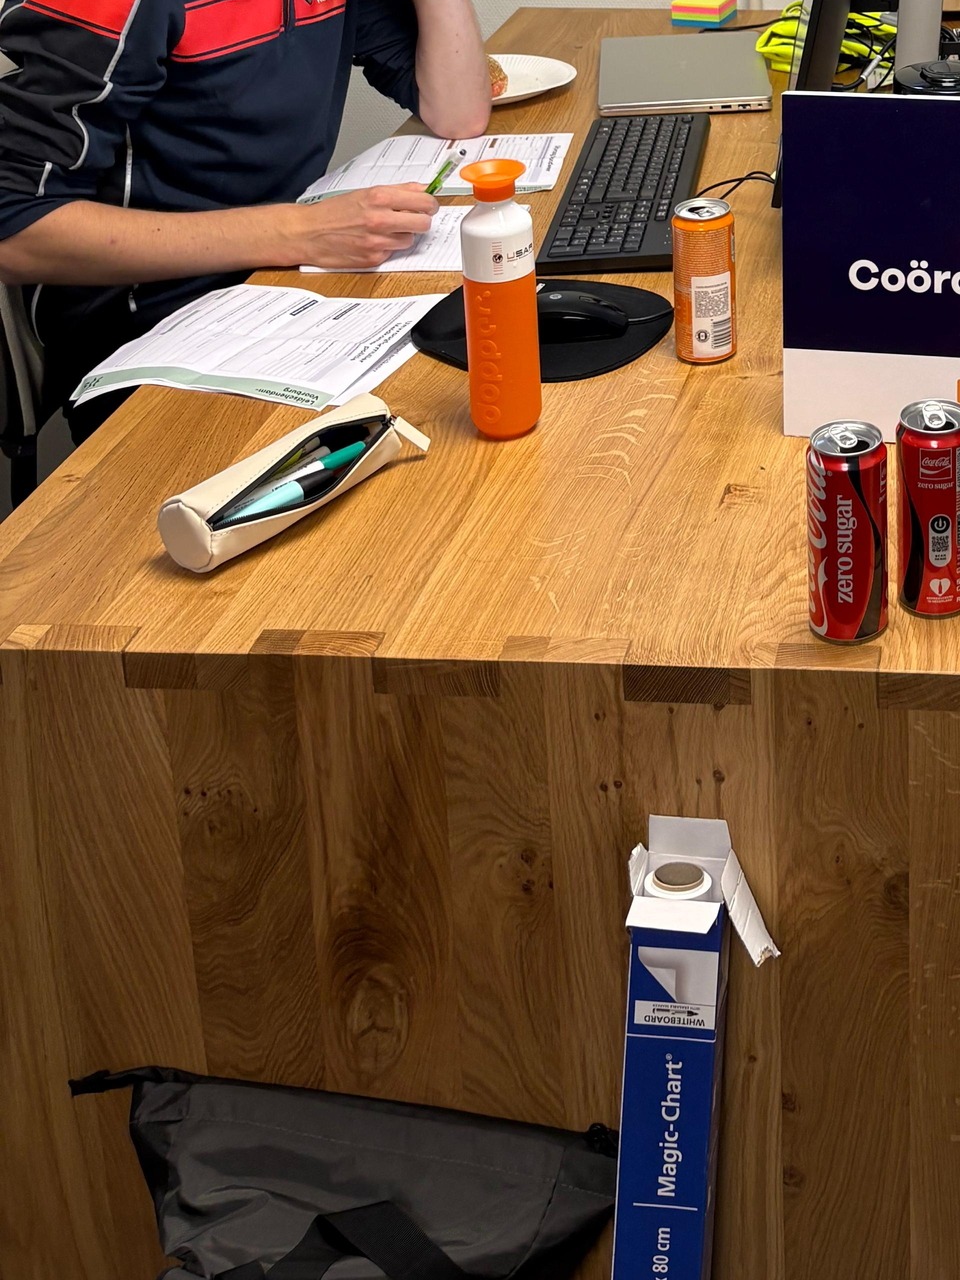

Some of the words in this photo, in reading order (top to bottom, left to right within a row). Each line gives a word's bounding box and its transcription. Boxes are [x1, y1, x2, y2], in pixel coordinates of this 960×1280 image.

[921, 456, 952, 468] Coca-Cola
[917, 482, 934, 490] zero
[935, 481, 954, 490] sugar
[836, 494, 858, 554] sugar
[837, 556, 853, 604] zero
[643, 1015, 706, 1028] WHITEBOARD
[655, 1227, 671, 1251] cm
[651, 1255, 669, 1274] 80
